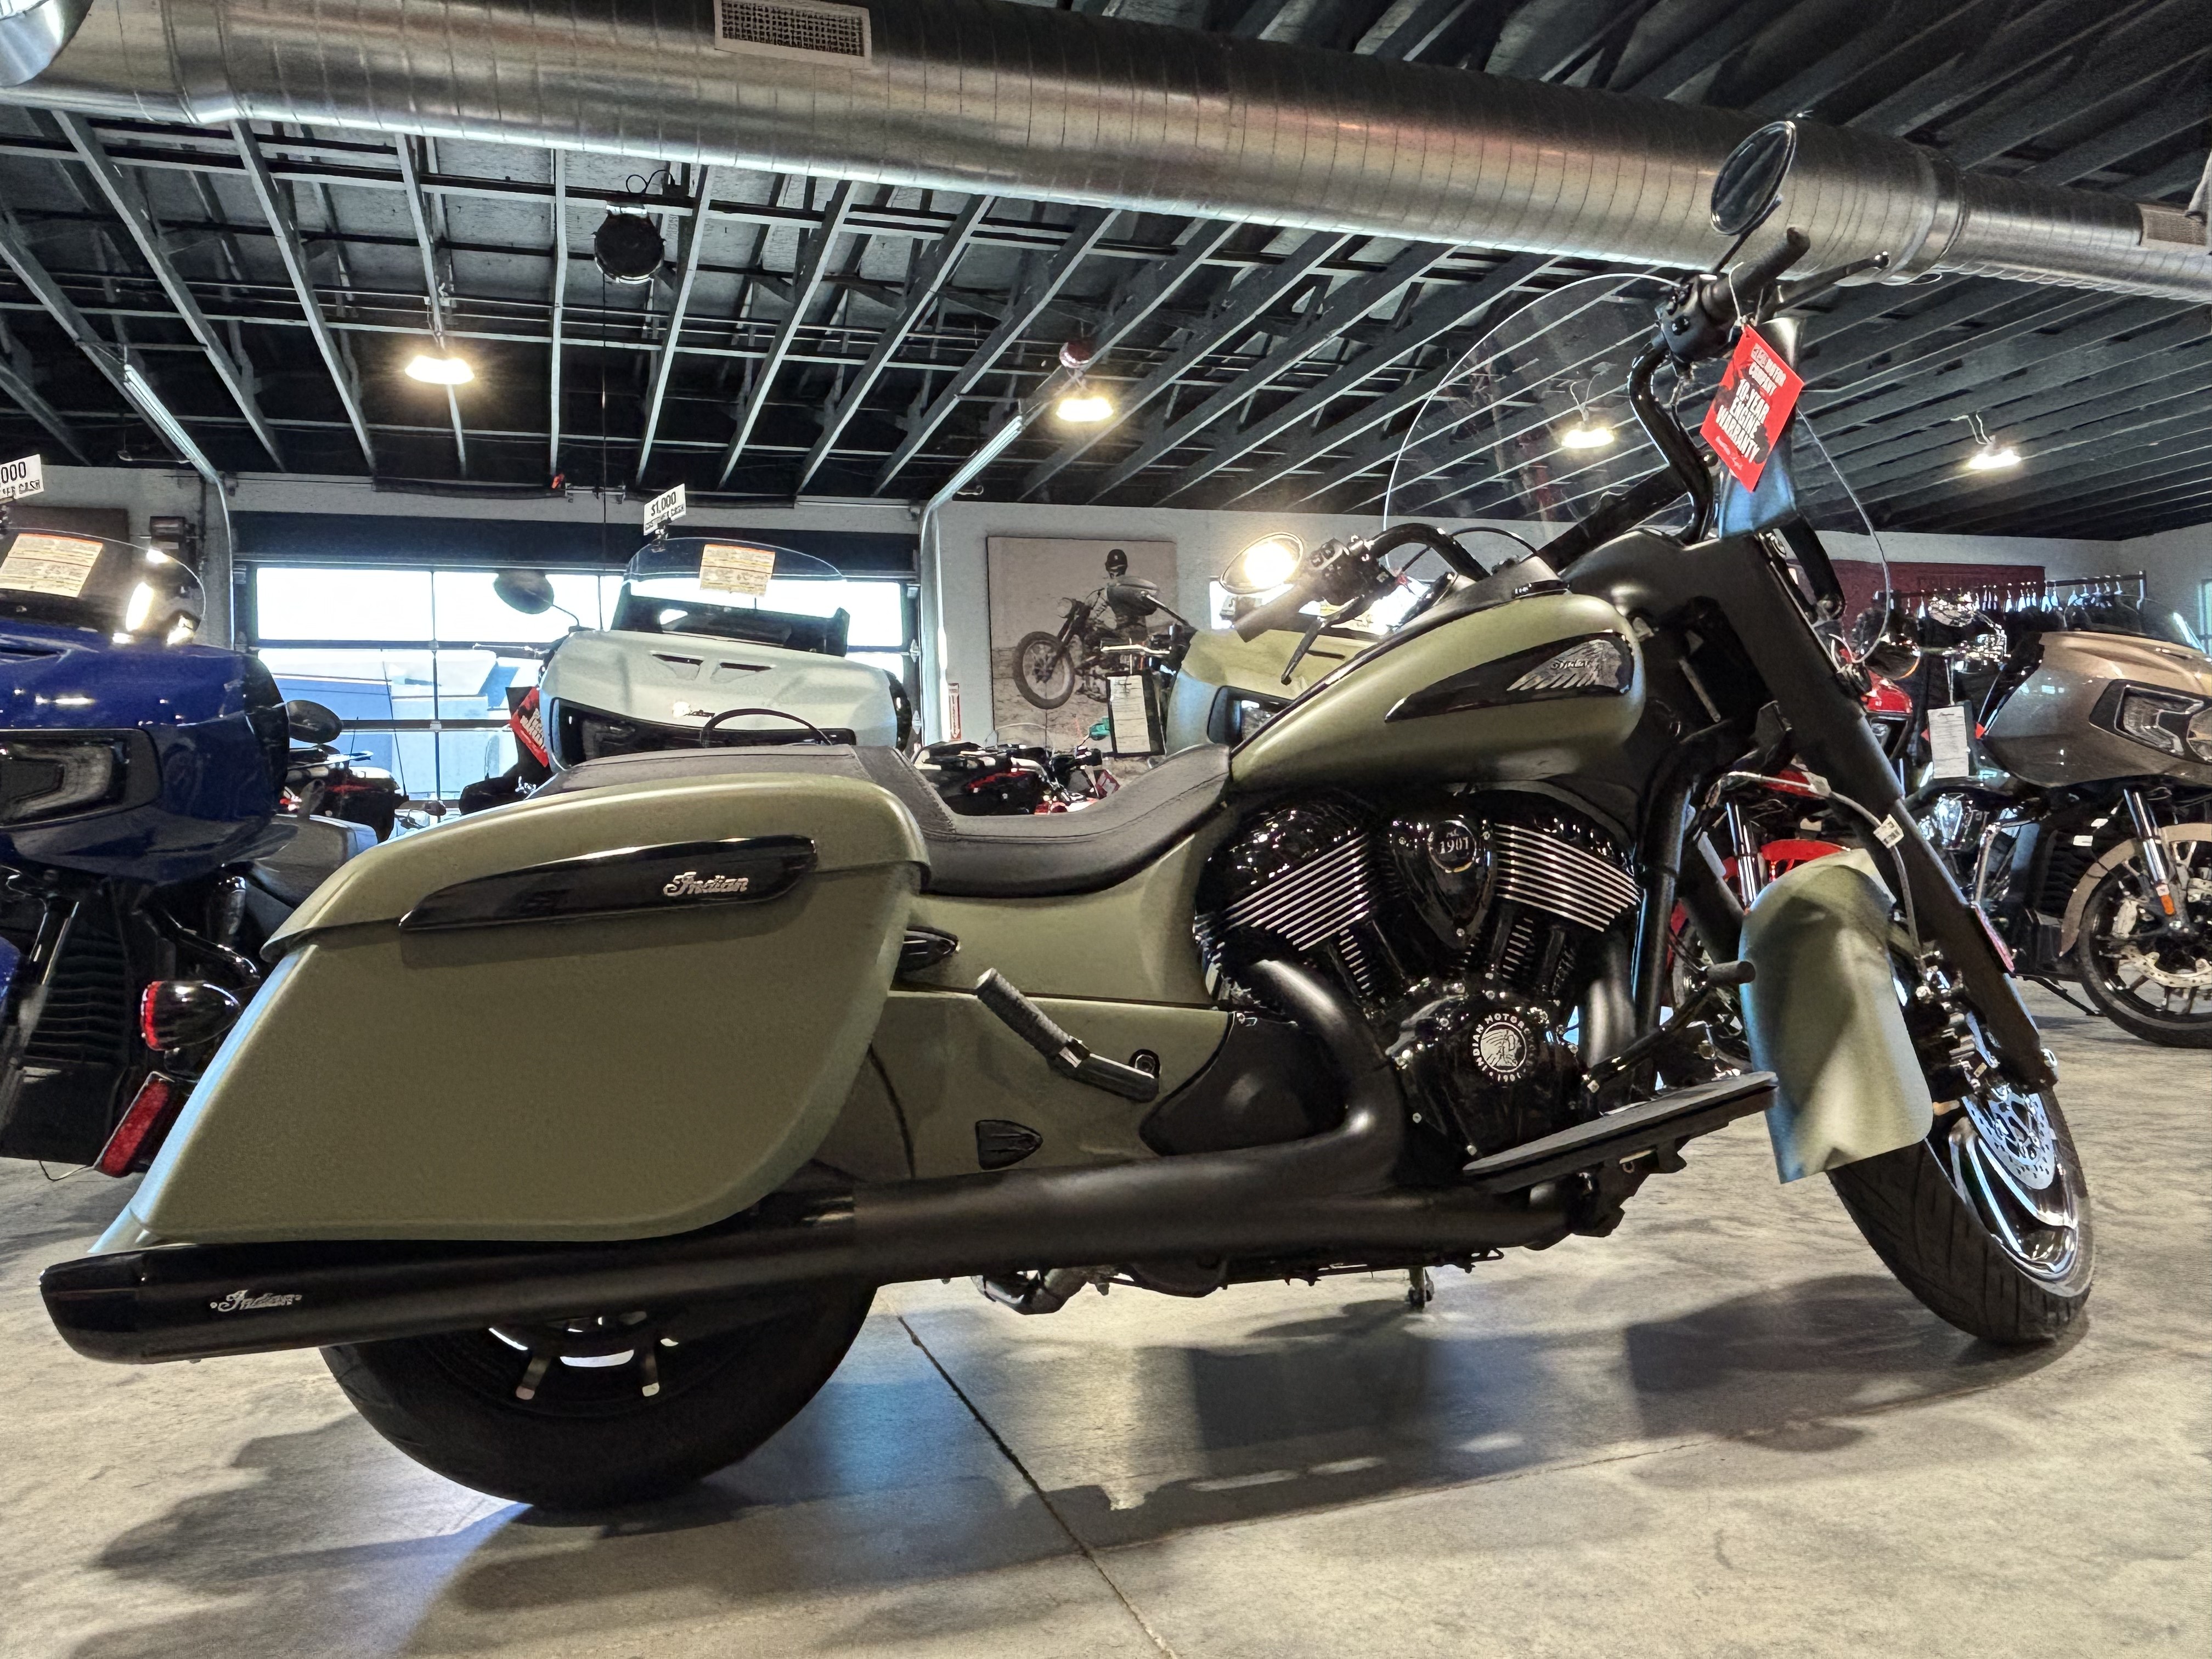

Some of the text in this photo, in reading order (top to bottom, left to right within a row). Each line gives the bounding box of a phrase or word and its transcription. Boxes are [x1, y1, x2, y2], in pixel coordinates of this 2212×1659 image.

[1716, 405, 1760, 464] WARRANTY
[1729, 397, 1761, 439] ENGINE
[0, 461, 26, 484] 000
[651, 491, 676, 517] $1,000
[663, 871, 749, 896] Indian
[1472, 1024, 1487, 1071] INDIAN
